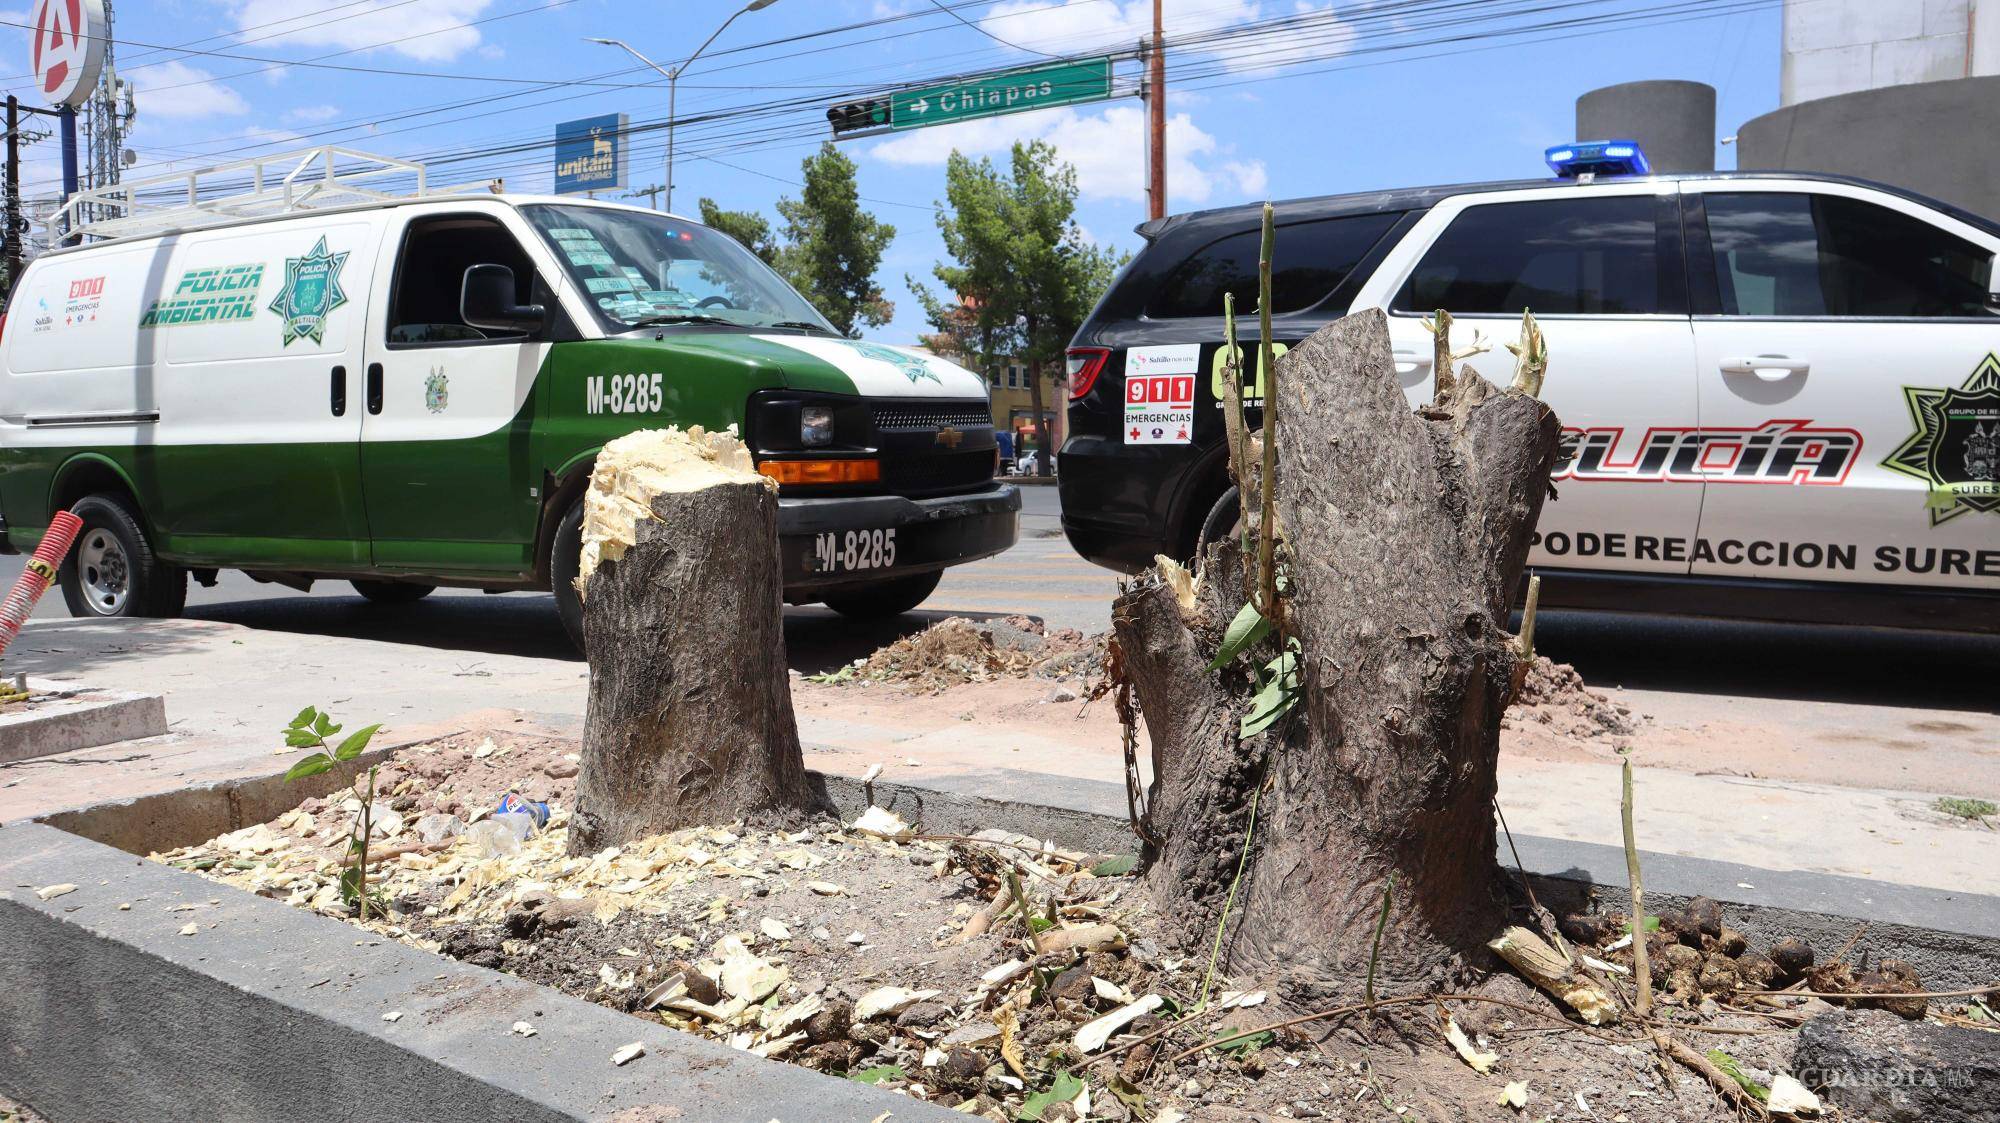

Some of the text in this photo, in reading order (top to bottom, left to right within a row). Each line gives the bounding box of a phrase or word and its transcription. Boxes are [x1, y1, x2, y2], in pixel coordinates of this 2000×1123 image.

[940, 80, 1052, 112] Chiapas
[557, 155, 612, 177] unitam
[70, 277, 105, 298] 911
[141, 295, 256, 325] AMBIENTAL
[587, 373, 663, 414] M-8285
[1129, 379, 1189, 401] 911
[1125, 413, 1191, 423] EMERGENCIAS
[815, 528, 896, 572] M-8285
[1635, 535, 1857, 570] REACCION
